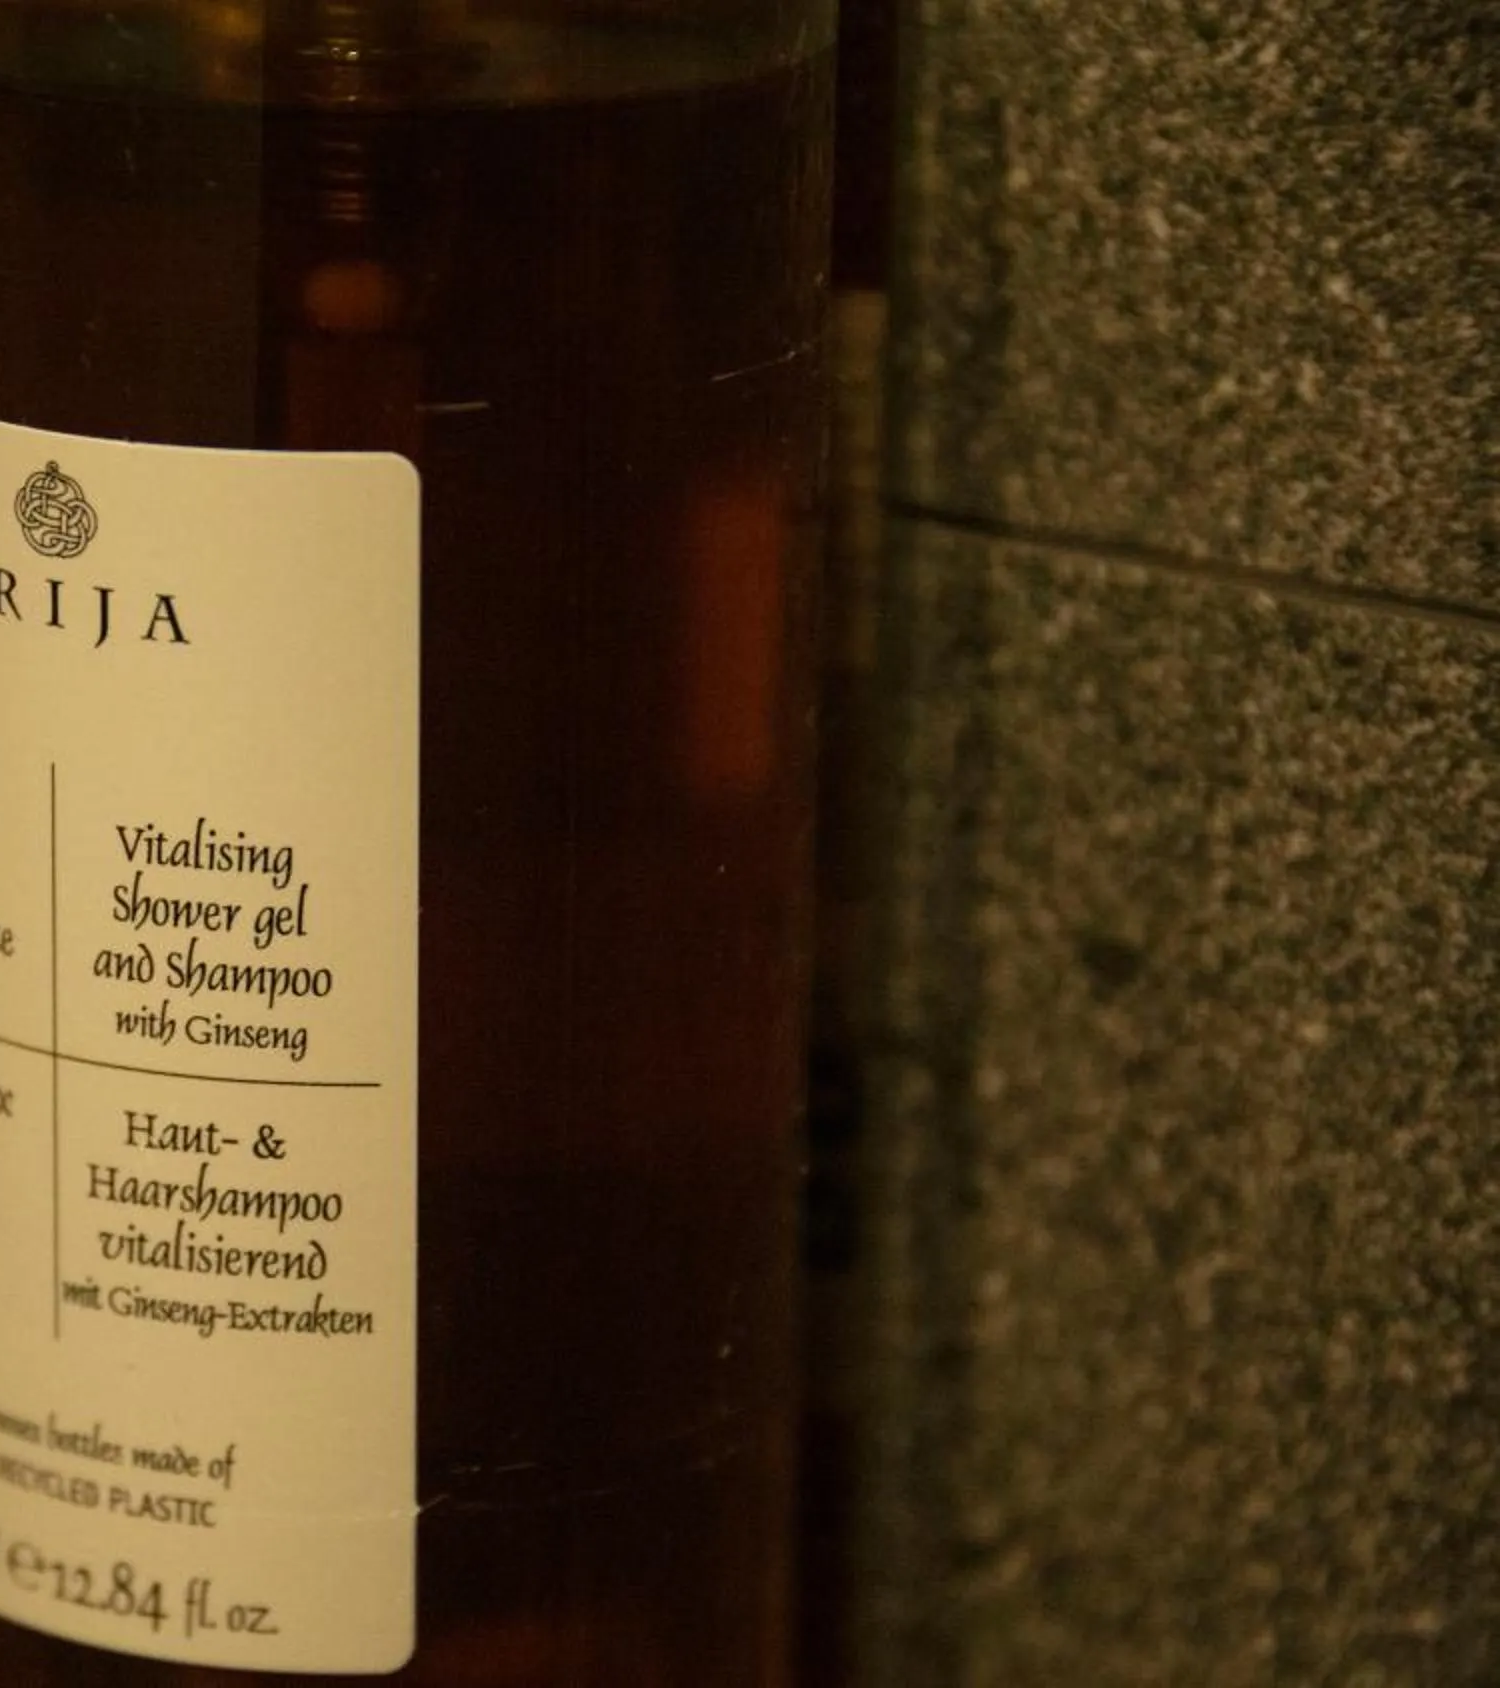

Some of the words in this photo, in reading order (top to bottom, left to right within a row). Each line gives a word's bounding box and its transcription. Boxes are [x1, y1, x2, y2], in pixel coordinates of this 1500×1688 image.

[115, 816, 295, 891] Vitalising
[112, 870, 243, 931] Shower
[253, 883, 310, 951] gel
[92, 943, 156, 985] and
[165, 936, 334, 1011] Shampoo
[115, 999, 177, 1047] with
[184, 1013, 310, 1063] Ginseng
[122, 1109, 240, 1157] Haut-
[250, 1123, 289, 1161] &
[86, 1161, 344, 1236] Haarshampoo
[97, 1218, 329, 1281] vitalisierend
[61, 1275, 104, 1311] mit
[107, 1292, 376, 1339] Ginseng-Extrakten
[46, 1411, 124, 1465] bottles
[130, 1443, 199, 1478] made
[206, 1443, 236, 1490] of
[108, 1486, 217, 1528] PLASTIC
